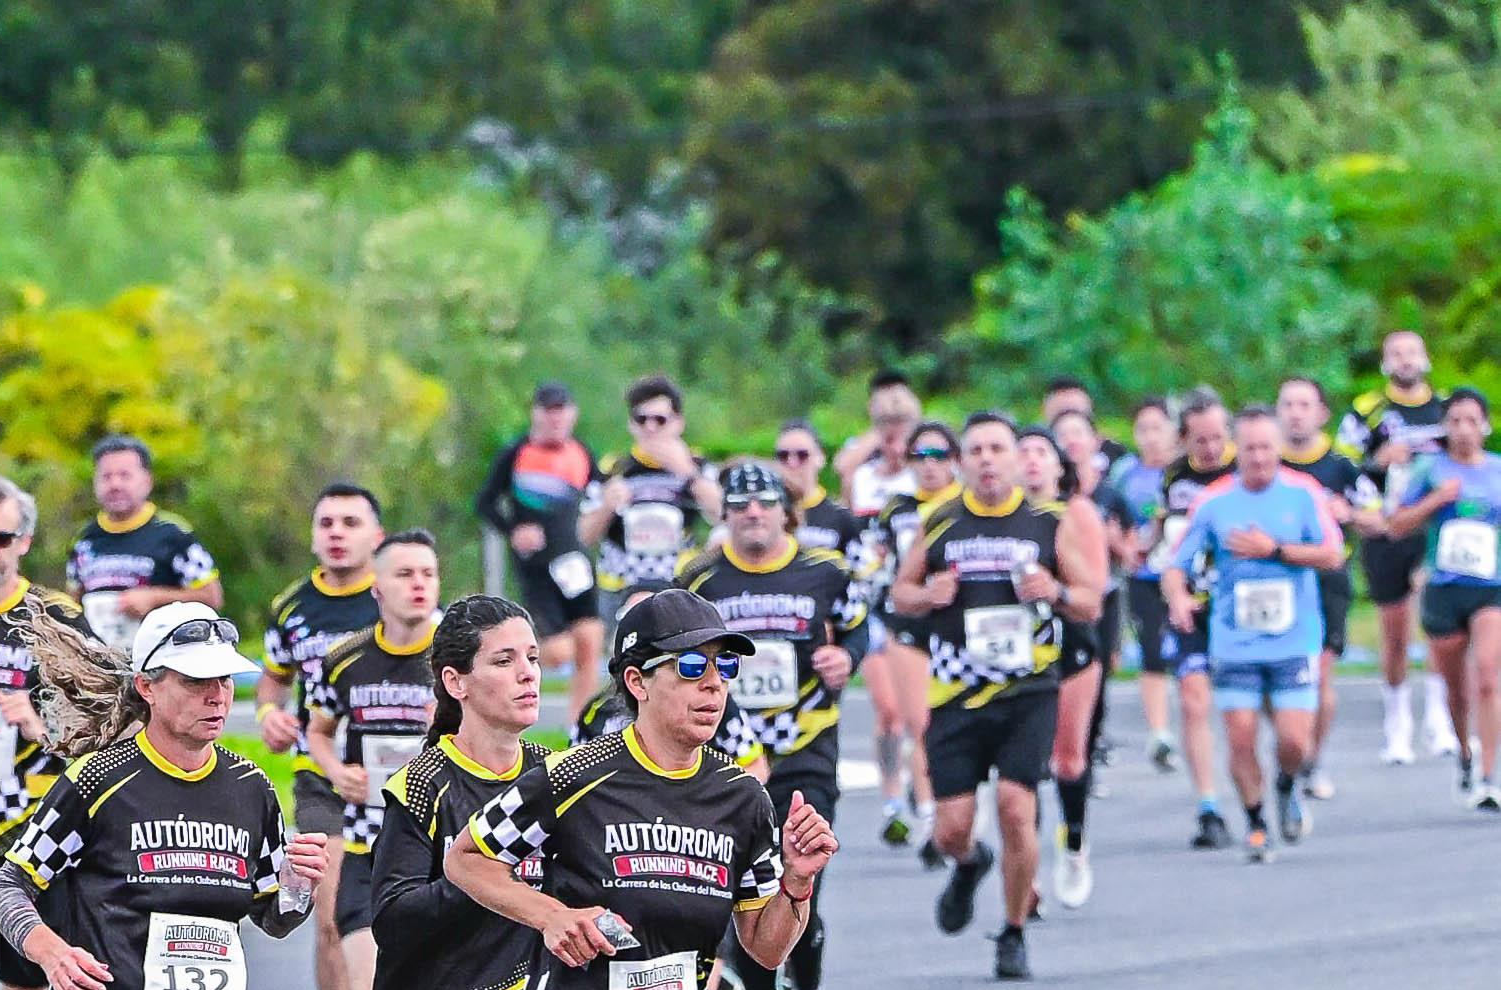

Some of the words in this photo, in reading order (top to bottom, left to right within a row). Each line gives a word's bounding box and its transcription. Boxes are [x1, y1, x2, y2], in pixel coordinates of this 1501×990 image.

[131, 813, 250, 858] AUTÓDROMO
[604, 816, 734, 865] AUTÓDROMO
[153, 852, 206, 870] RUNNING
[210, 855, 239, 875] RACE
[525, 860, 544, 877] RA
[629, 856, 687, 874] RUNNING
[688, 861, 719, 883] RACE
[138, 874, 171, 884] Carrera
[602, 878, 614, 888] La
[614, 878, 648, 888] Carrera
[648, 879, 660, 889] de
[165, 921, 232, 946] AUTÓDROMO
